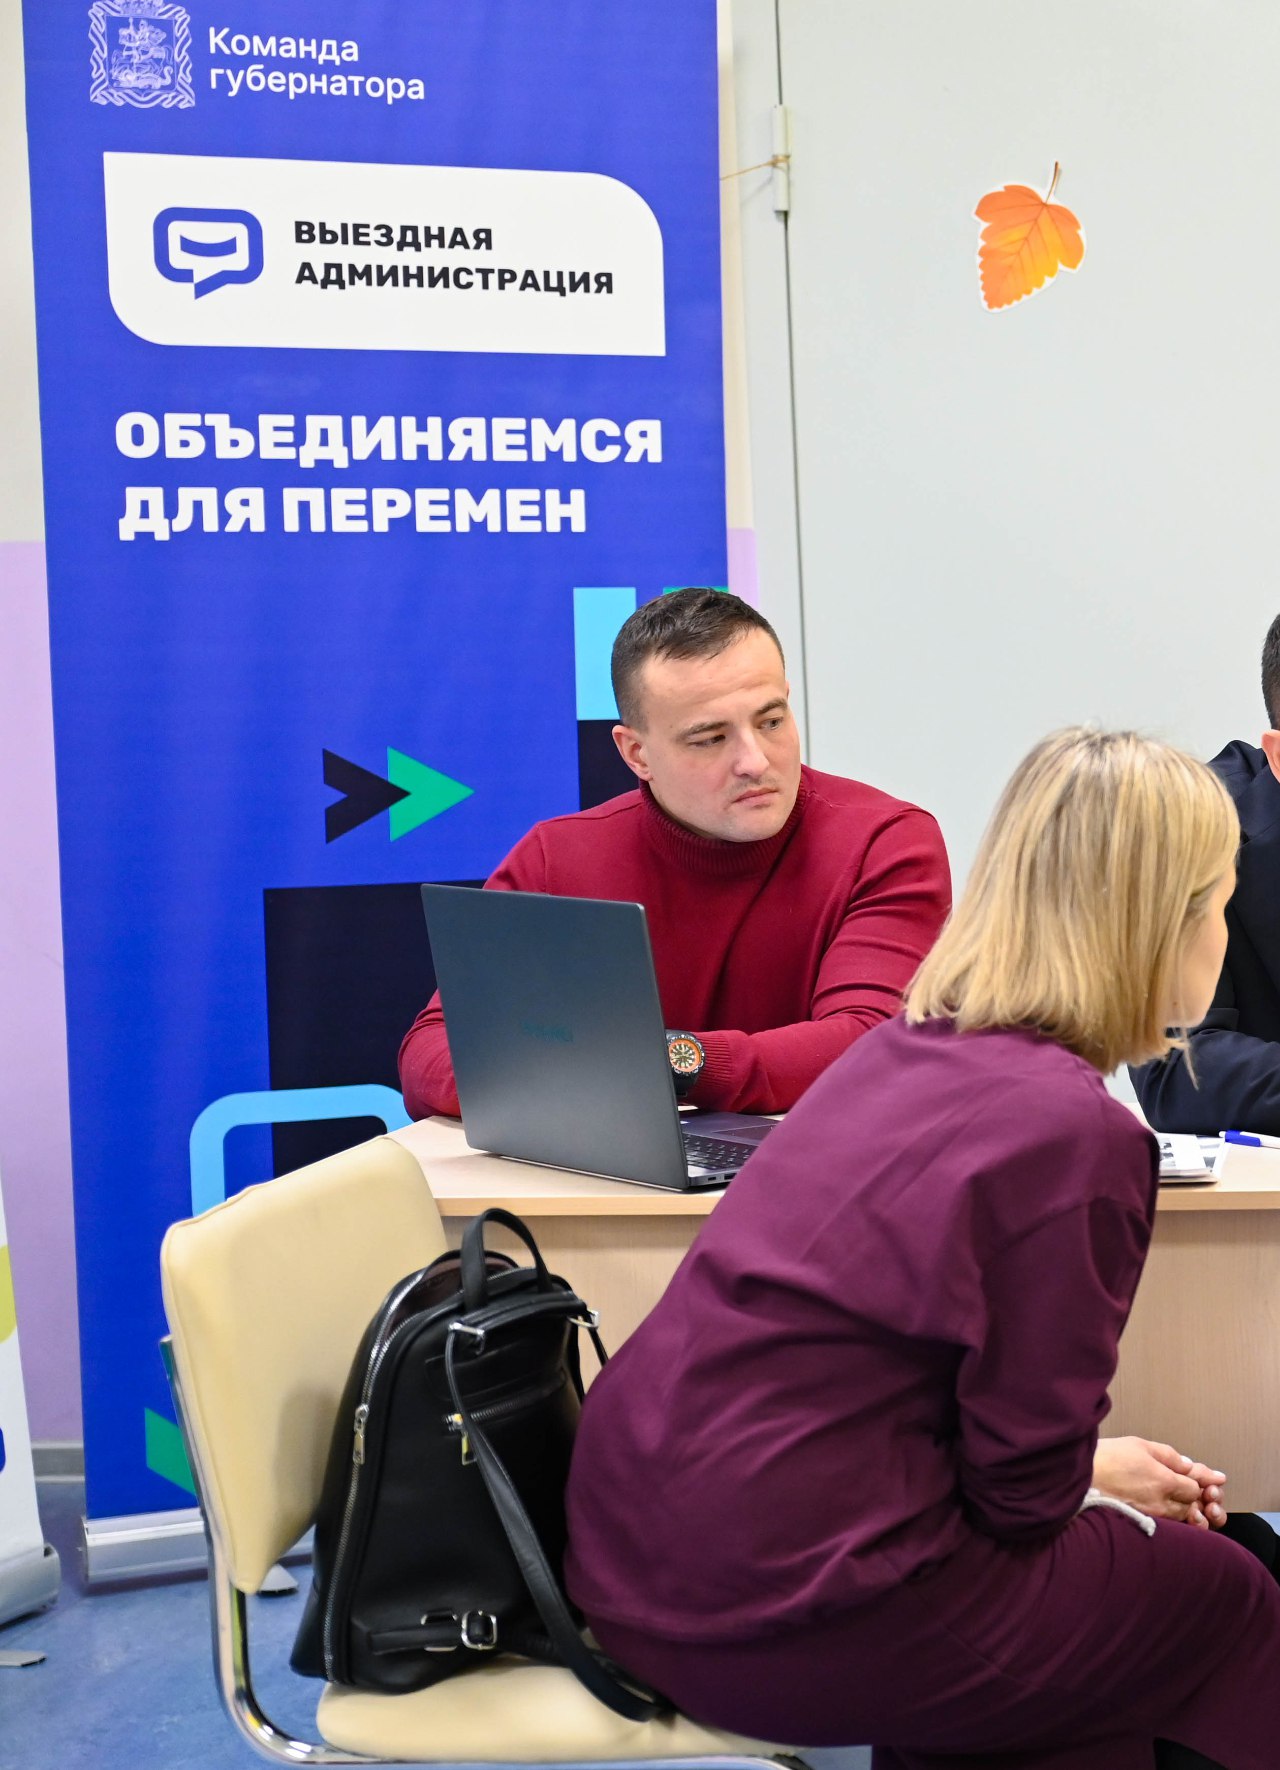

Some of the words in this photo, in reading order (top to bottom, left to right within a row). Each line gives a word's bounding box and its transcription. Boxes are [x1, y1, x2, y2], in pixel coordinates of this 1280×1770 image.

[208, 26, 359, 66] Команда
[209, 64, 425, 105] губернатора
[294, 220, 493, 252] ВЫЕЗДНАЯ
[295, 261, 614, 297] АДМИНИСТРАЦИЯ
[115, 411, 663, 469] ОБЪЕДИНЯЕМСЯ
[118, 486, 266, 541] ДЛЯ
[282, 487, 587, 533] ПЕРЕМЕН
